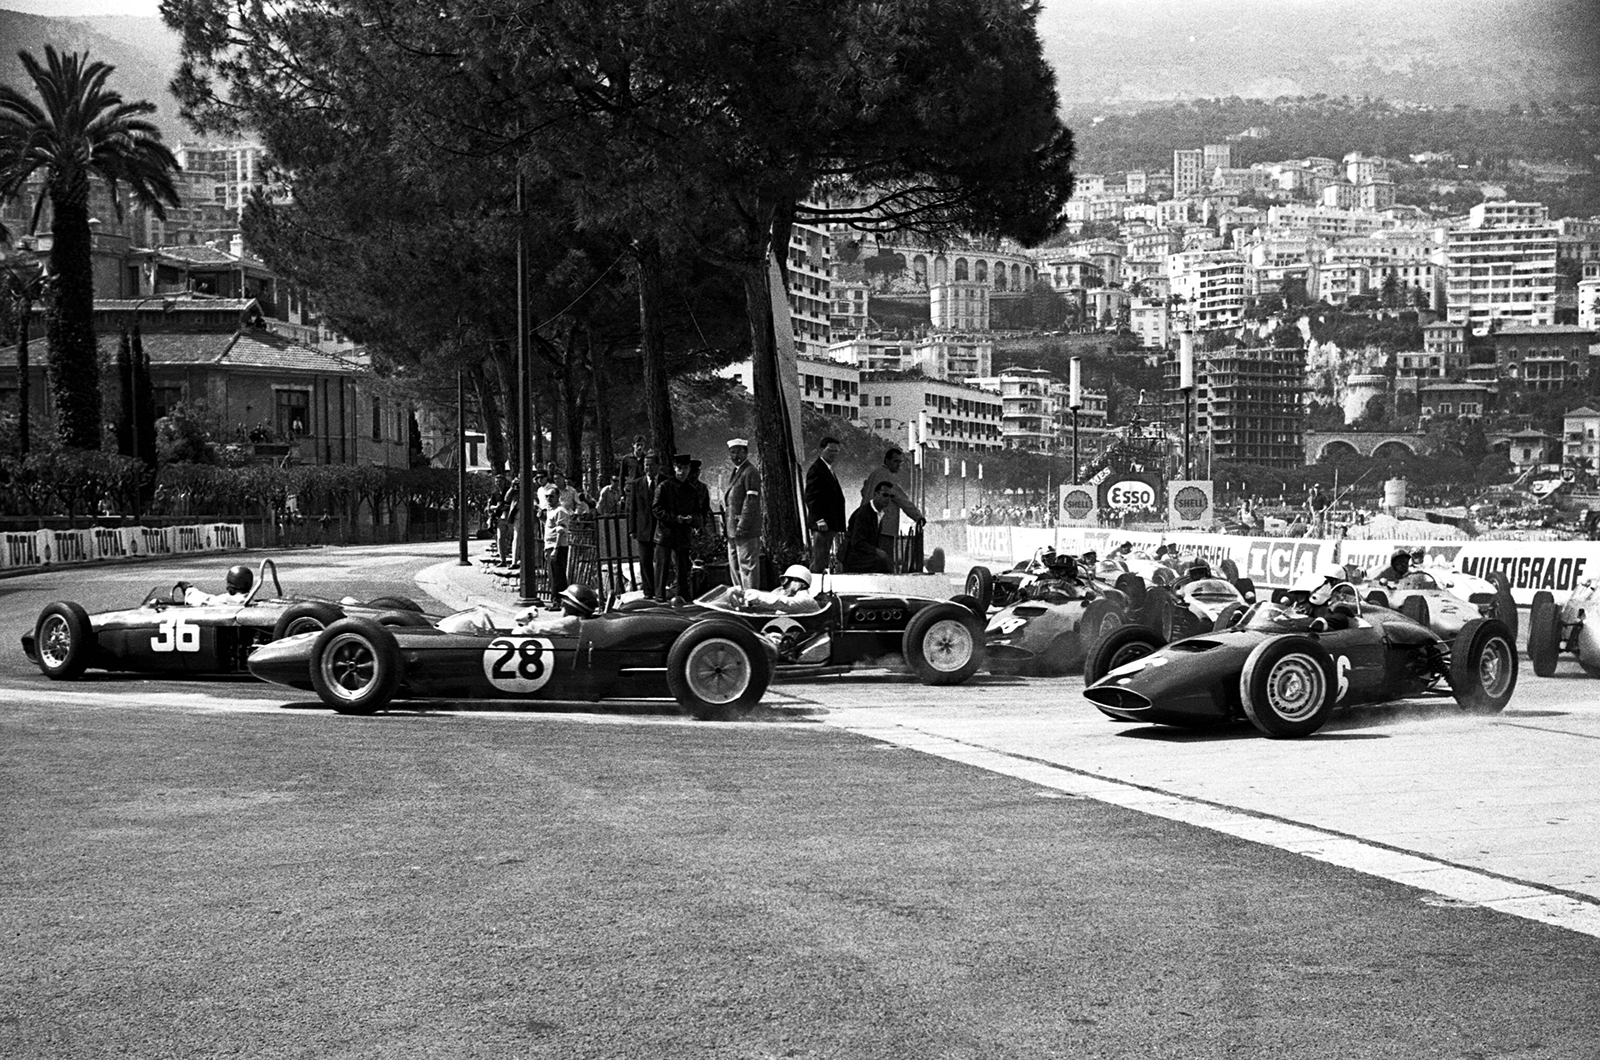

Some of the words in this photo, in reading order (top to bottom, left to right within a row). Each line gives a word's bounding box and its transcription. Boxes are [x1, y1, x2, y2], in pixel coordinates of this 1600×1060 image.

[1067, 500, 1089, 508] SHELL
[1178, 498, 1204, 508] SHELL
[6, 534, 41, 566] TOTAL
[54, 532, 87, 562] TOTAL
[95, 529, 127, 556] TOTAL
[141, 528, 171, 554] TOTAL
[179, 527, 203, 551] TOTAL
[214, 525, 241, 548] TOTAL
[1250, 547, 1317, 580] ICA
[151, 611, 200, 652] 36
[492, 639, 545, 680] 28
